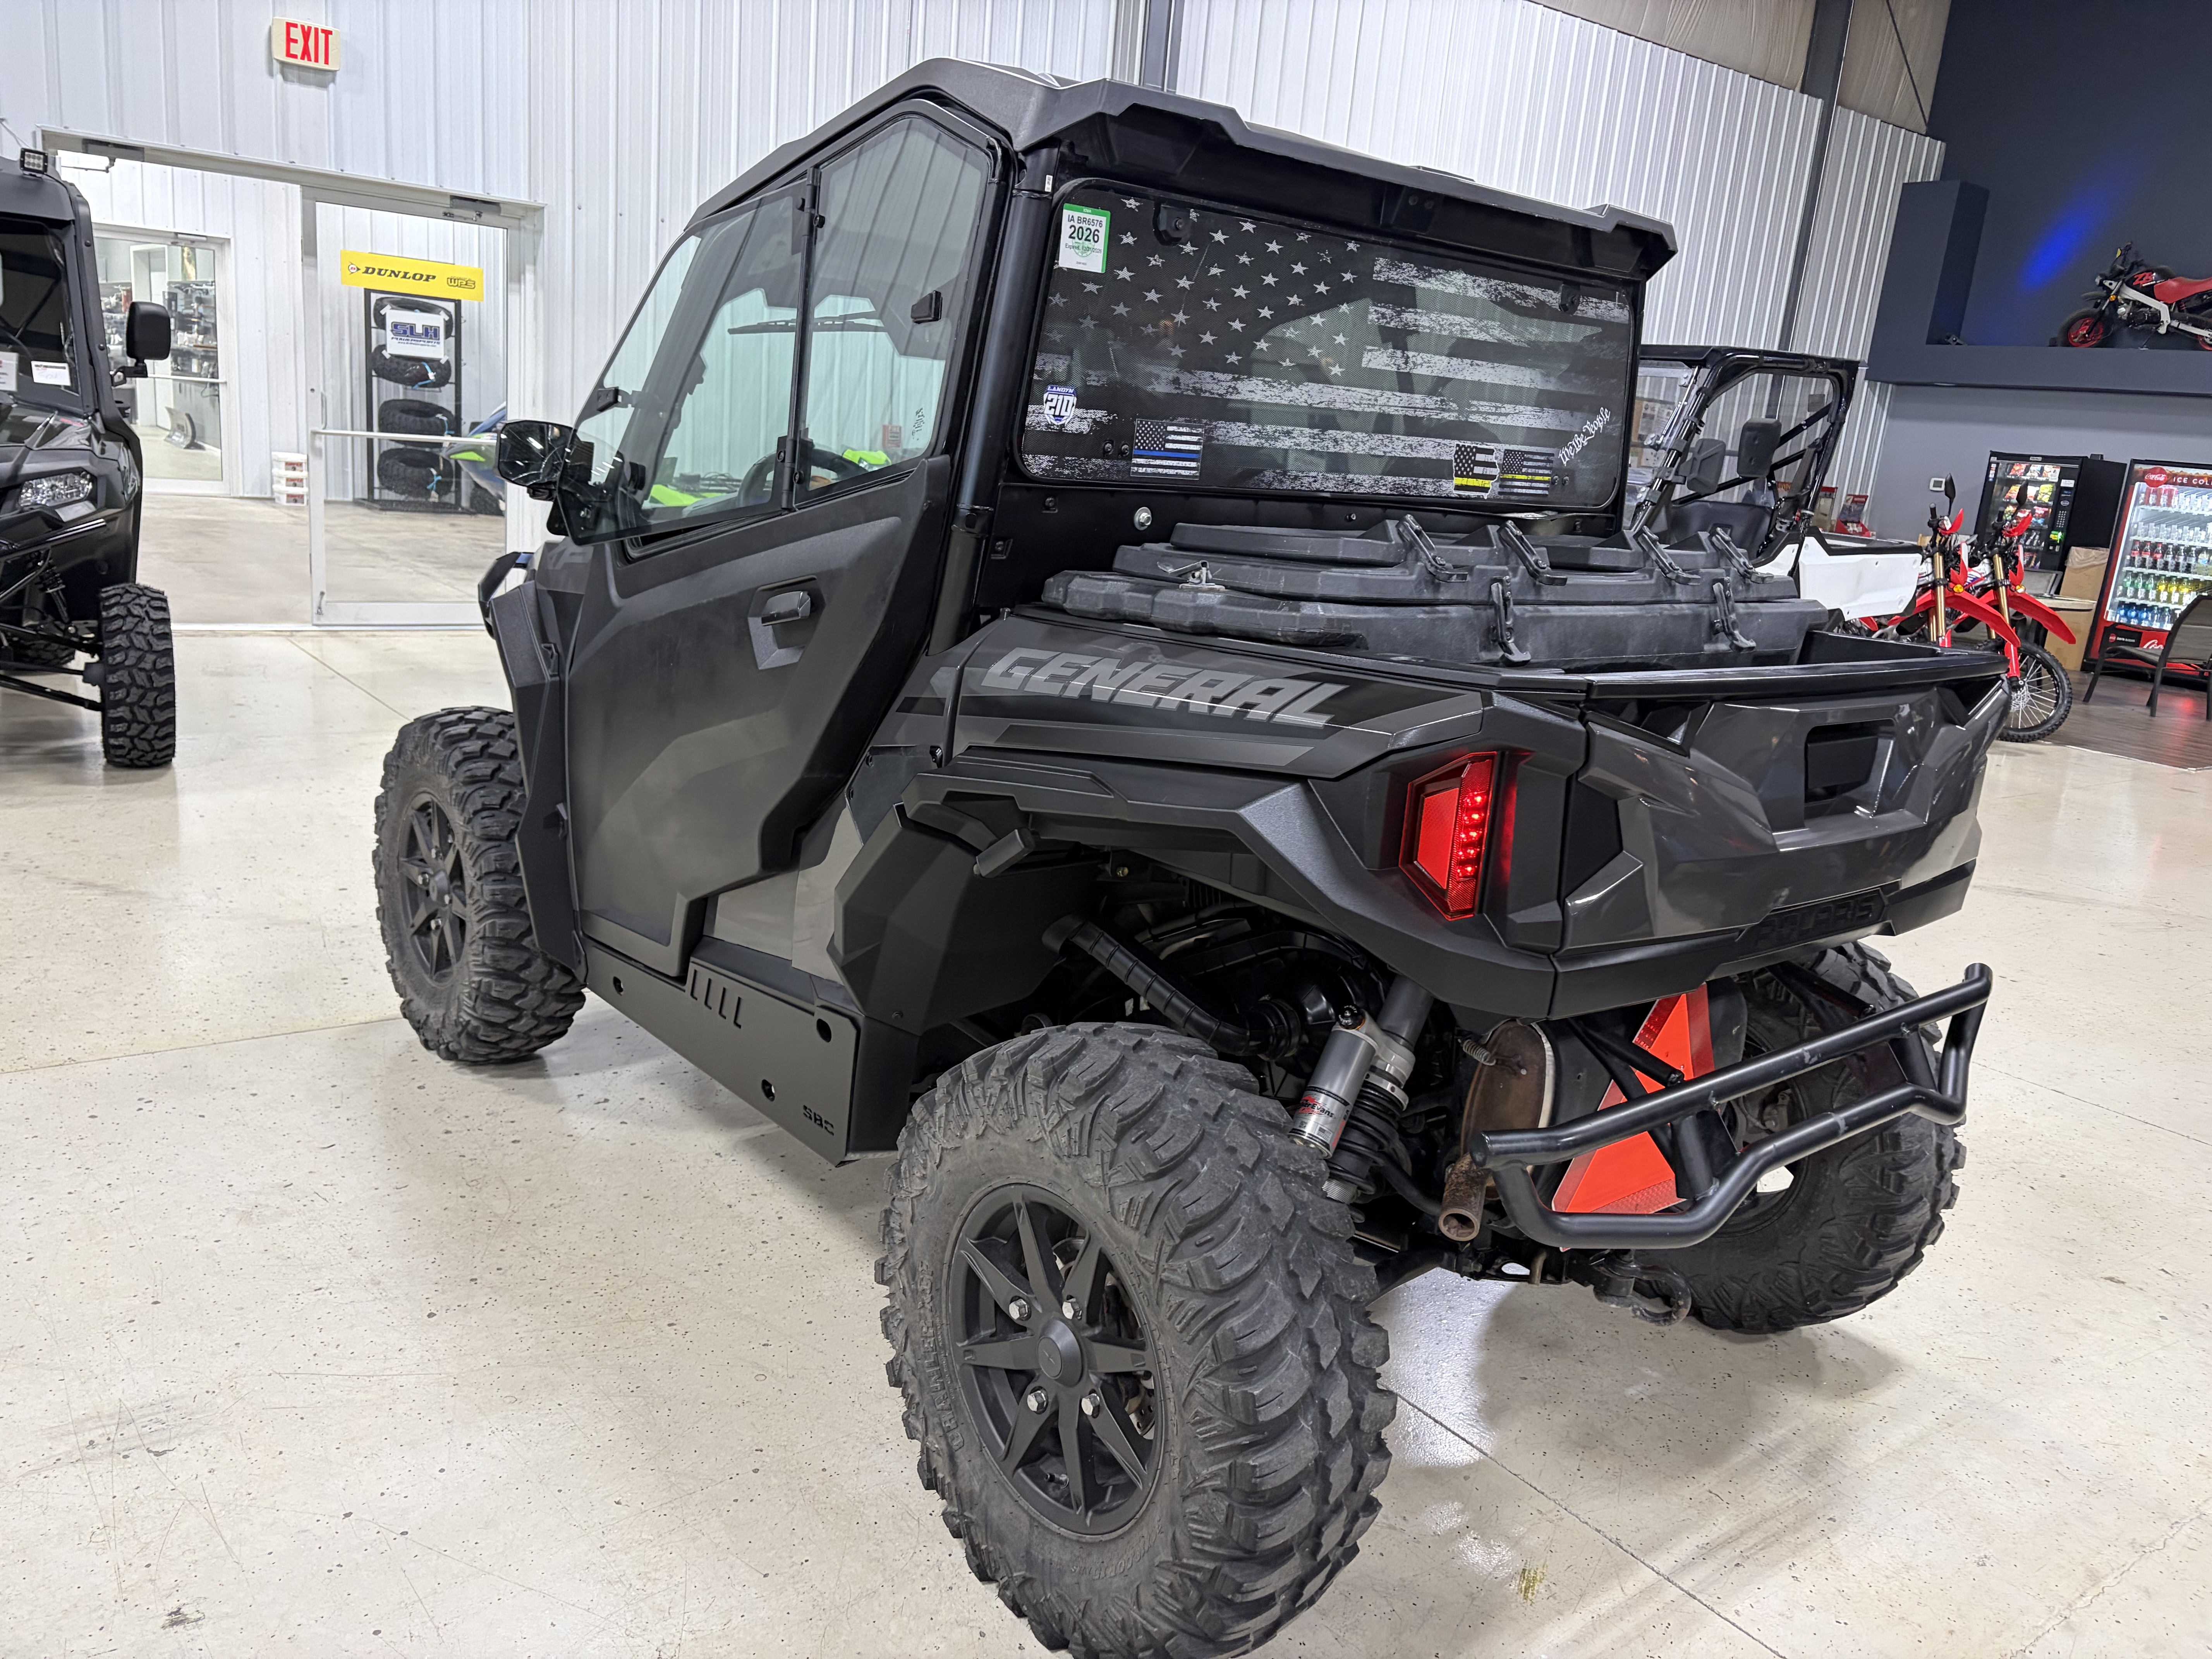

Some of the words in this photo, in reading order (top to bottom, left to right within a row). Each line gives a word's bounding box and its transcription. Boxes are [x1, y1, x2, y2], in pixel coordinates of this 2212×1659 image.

[285, 22, 333, 65] EXIT
[1068, 214, 1075, 223] IA
[1077, 216, 1103, 228] BR6576
[1068, 225, 1100, 243] 2026
[362, 266, 436, 282] DUNLOP
[447, 277, 476, 289] WPS
[390, 321, 440, 341] SLH
[1044, 393, 1074, 417] 210
[981, 647, 1350, 729] GENERAL
[803, 1105, 834, 1136] SBC
